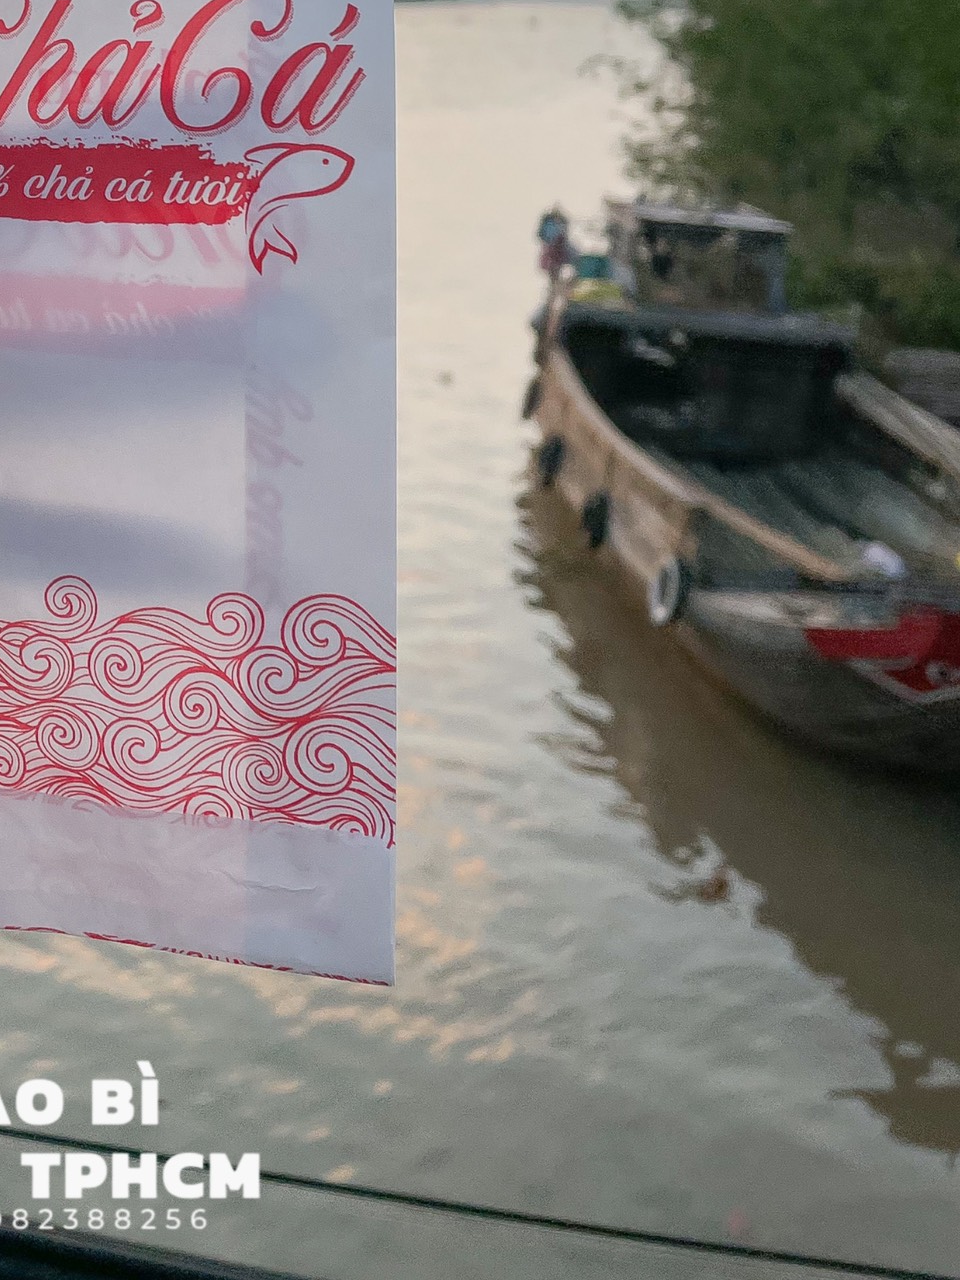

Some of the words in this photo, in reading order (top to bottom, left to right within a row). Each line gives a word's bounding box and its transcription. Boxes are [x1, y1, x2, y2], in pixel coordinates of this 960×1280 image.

[22, 164, 94, 202] chả
[104, 170, 154, 203] cá
[162, 170, 246, 207] tươi
